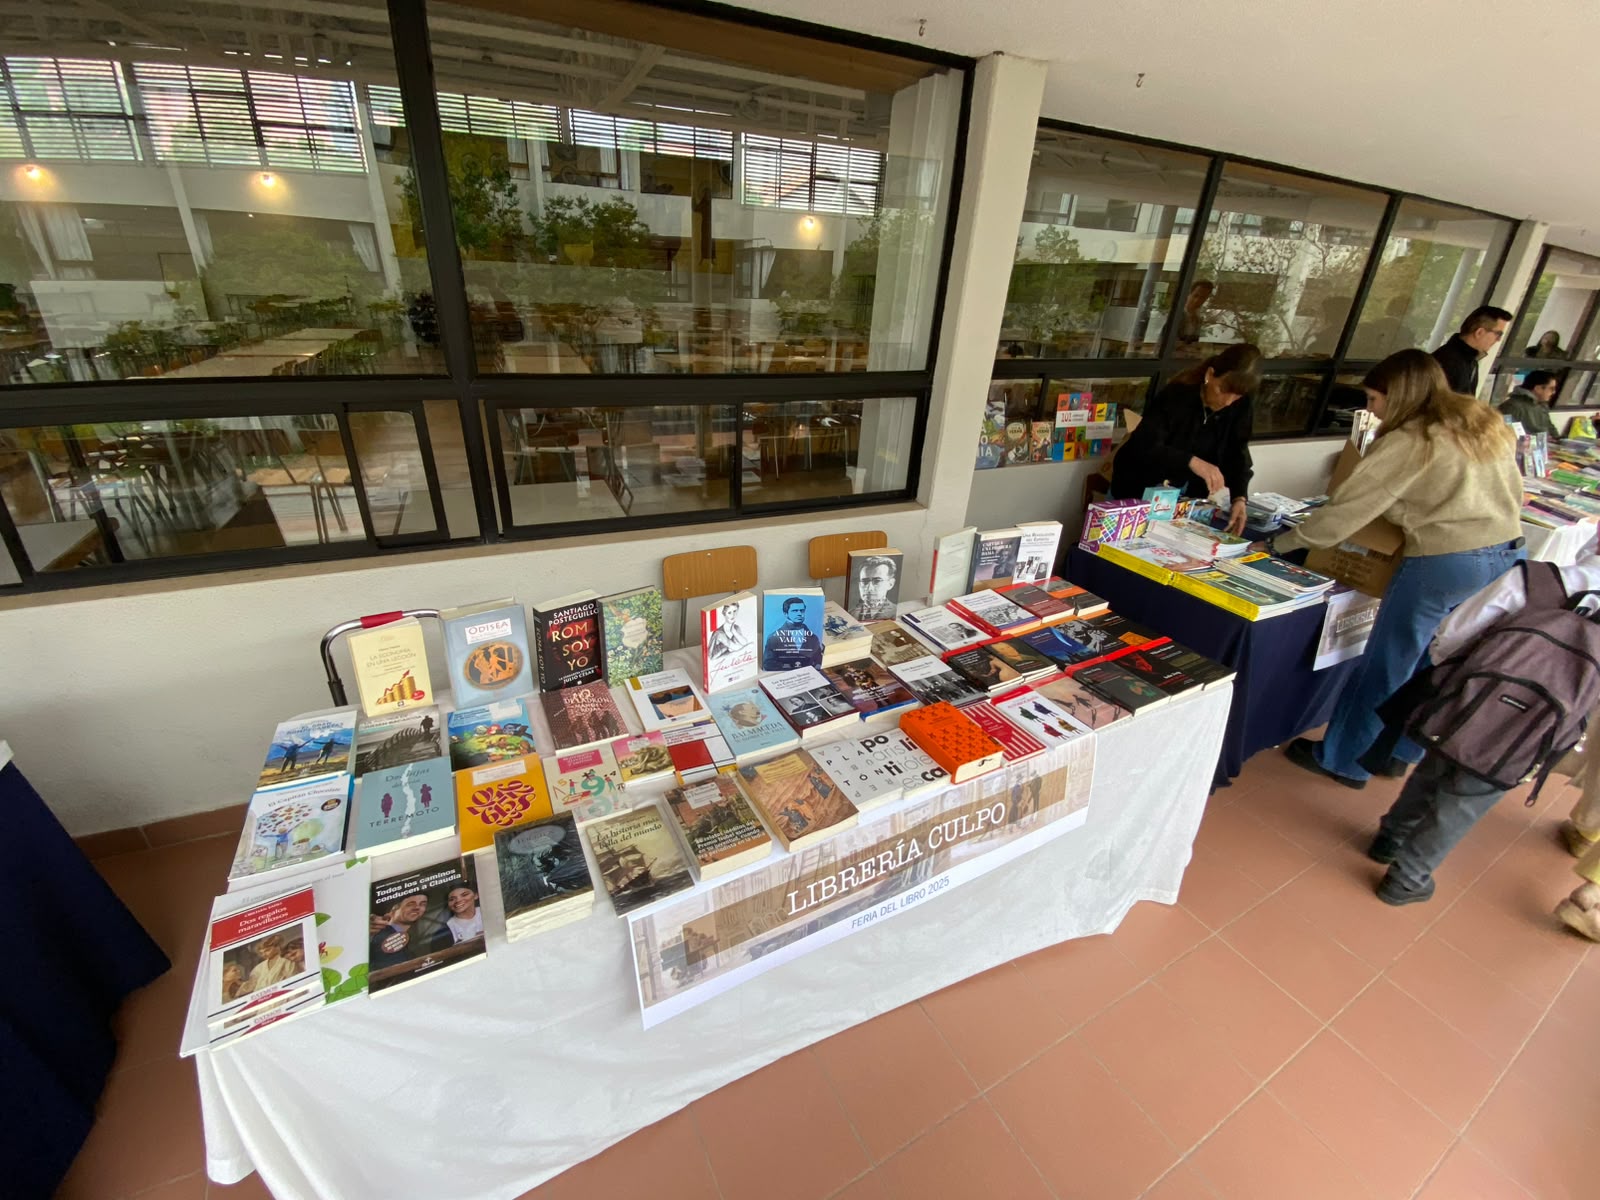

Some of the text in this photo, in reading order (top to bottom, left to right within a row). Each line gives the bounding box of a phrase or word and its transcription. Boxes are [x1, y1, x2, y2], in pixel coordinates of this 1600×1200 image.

[549, 608, 599, 627] POSTEGUILLO
[554, 603, 595, 619] SANTIAGO
[469, 621, 509, 635] ODISEA
[774, 629, 813, 637] ANTONIO
[563, 638, 591, 656] SOY
[567, 656, 588, 671] YO
[563, 675, 579, 684] JULIO
[860, 735, 889, 753] po
[921, 767, 948, 782] ca
[370, 806, 440, 828] TERREMOTO
[610, 824, 641, 839] historia
[620, 833, 632, 842] del
[634, 824, 662, 837] mundo
[697, 839, 717, 849] Premio
[718, 832, 735, 842] Nobel
[740, 829, 760, 839] cuando
[787, 802, 1006, 916] LIBRERÍA CULPO
[376, 869, 456, 897] Todos los caminos
[376, 887, 420, 904] conducen
[429, 873, 462, 887] Claudia
[851, 876, 950, 929] FERIA DEL LIBRO 2025
[238, 912, 289, 934] maravillosos
[239, 906, 287, 927] Dos regalos
